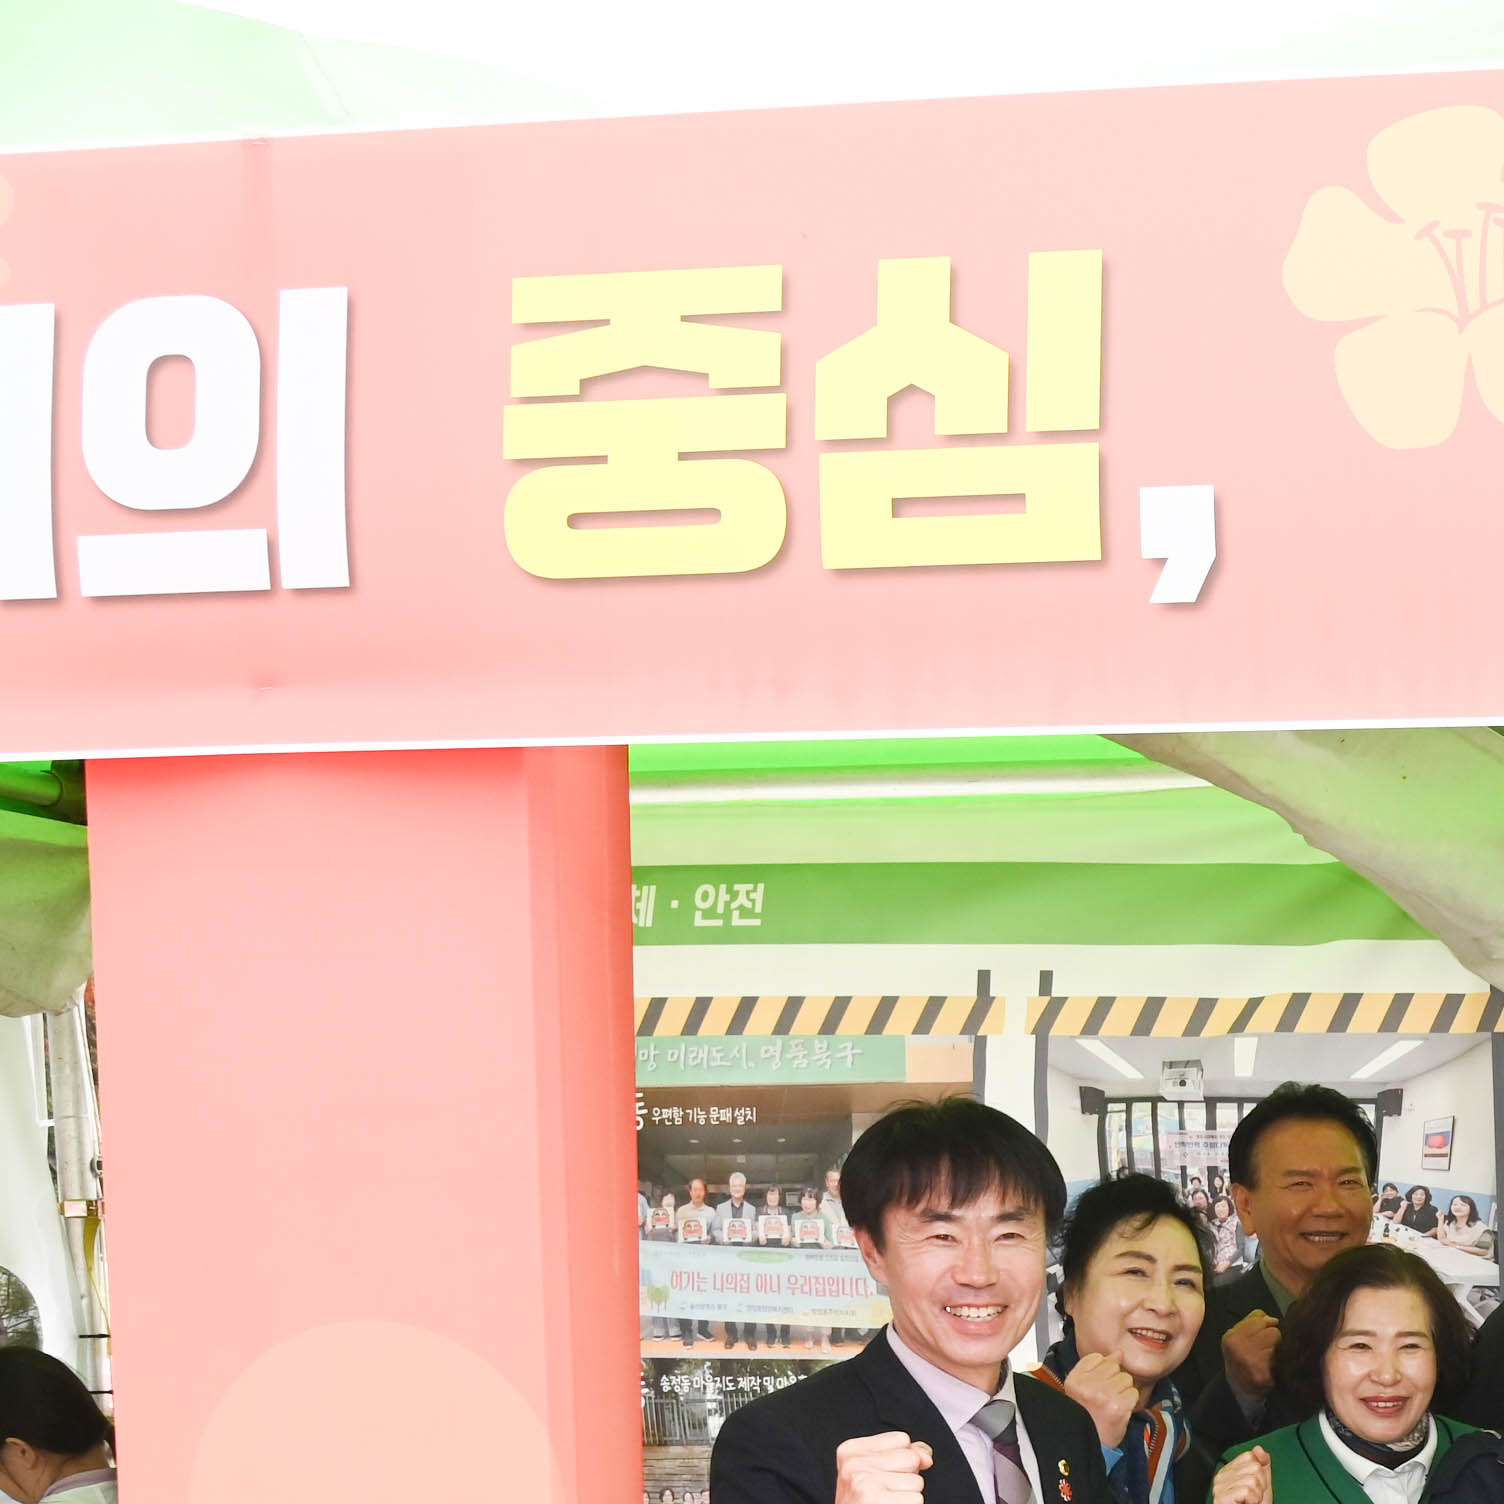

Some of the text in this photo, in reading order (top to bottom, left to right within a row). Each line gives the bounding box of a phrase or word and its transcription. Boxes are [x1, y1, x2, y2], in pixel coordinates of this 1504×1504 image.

[0, 248, 1219, 605] 의 중심,
[693, 882, 765, 927] 안전
[635, 1046, 658, 1071] 망
[761, 1039, 862, 1070] 명품북구
[651, 1108, 684, 1125] 우편함
[687, 1108, 708, 1125] 기능
[709, 1108, 732, 1125] 문패
[734, 1107, 756, 1125] 설치
[670, 1271, 708, 1293] 여기는
[713, 1272, 750, 1293] 나의집
[787, 1275, 874, 1299] 우리집입니다.
[660, 1374, 692, 1392] 송정동
[737, 1375, 761, 1393] 제작
